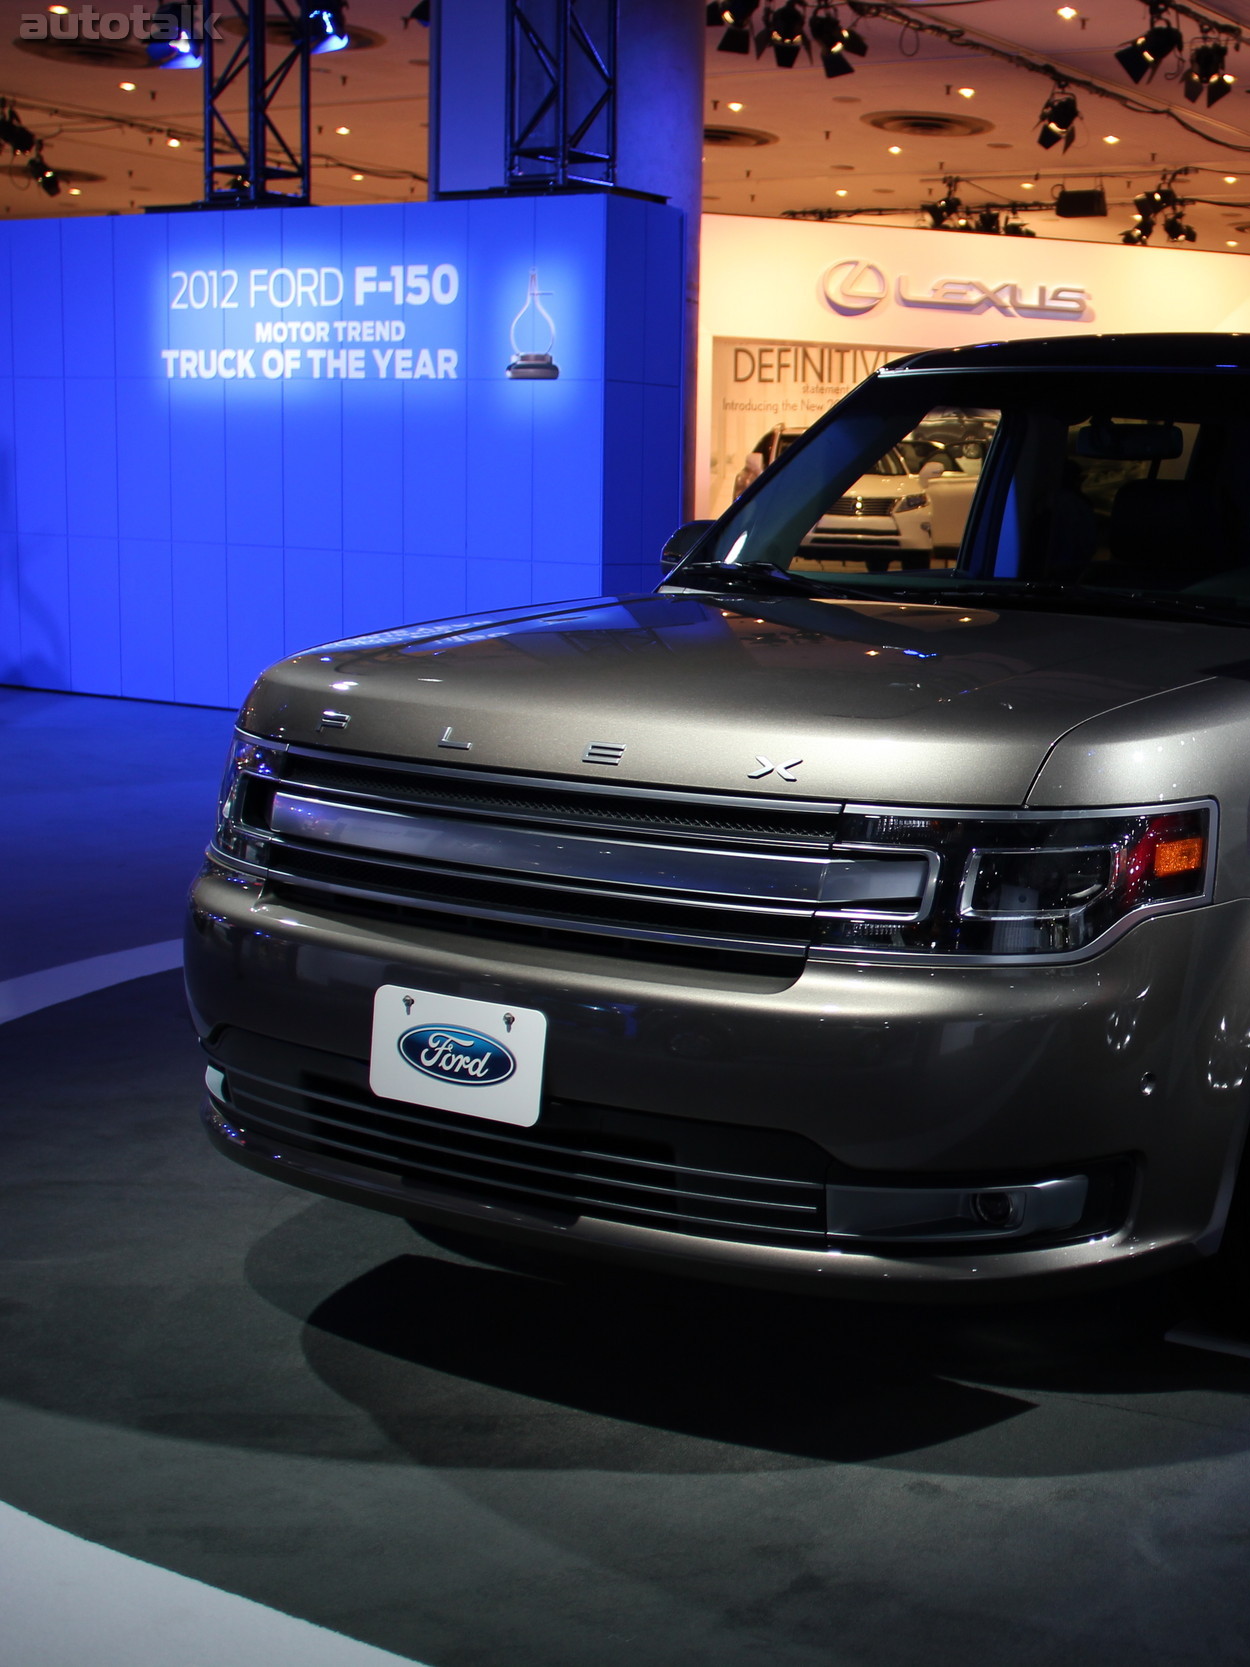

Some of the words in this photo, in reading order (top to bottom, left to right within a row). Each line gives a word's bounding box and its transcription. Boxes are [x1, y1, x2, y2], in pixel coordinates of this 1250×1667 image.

[170, 270, 239, 310] 2012
[249, 267, 344, 309] FORD
[354, 264, 459, 306] F-150
[896, 274, 1089, 318] LEXUS
[255, 322, 330, 343] MOTOR
[333, 320, 406, 342] TREND
[161, 349, 256, 379] TRUCK
[261, 349, 300, 379] OF
[307, 349, 366, 379] THE
[372, 349, 458, 379] YEAR
[734, 347, 888, 384] DEFINITIV
[722, 398, 779, 414] Introducing
[781, 399, 798, 412] the
[801, 398, 823, 412] New
[420, 1032, 491, 1078] Ford
